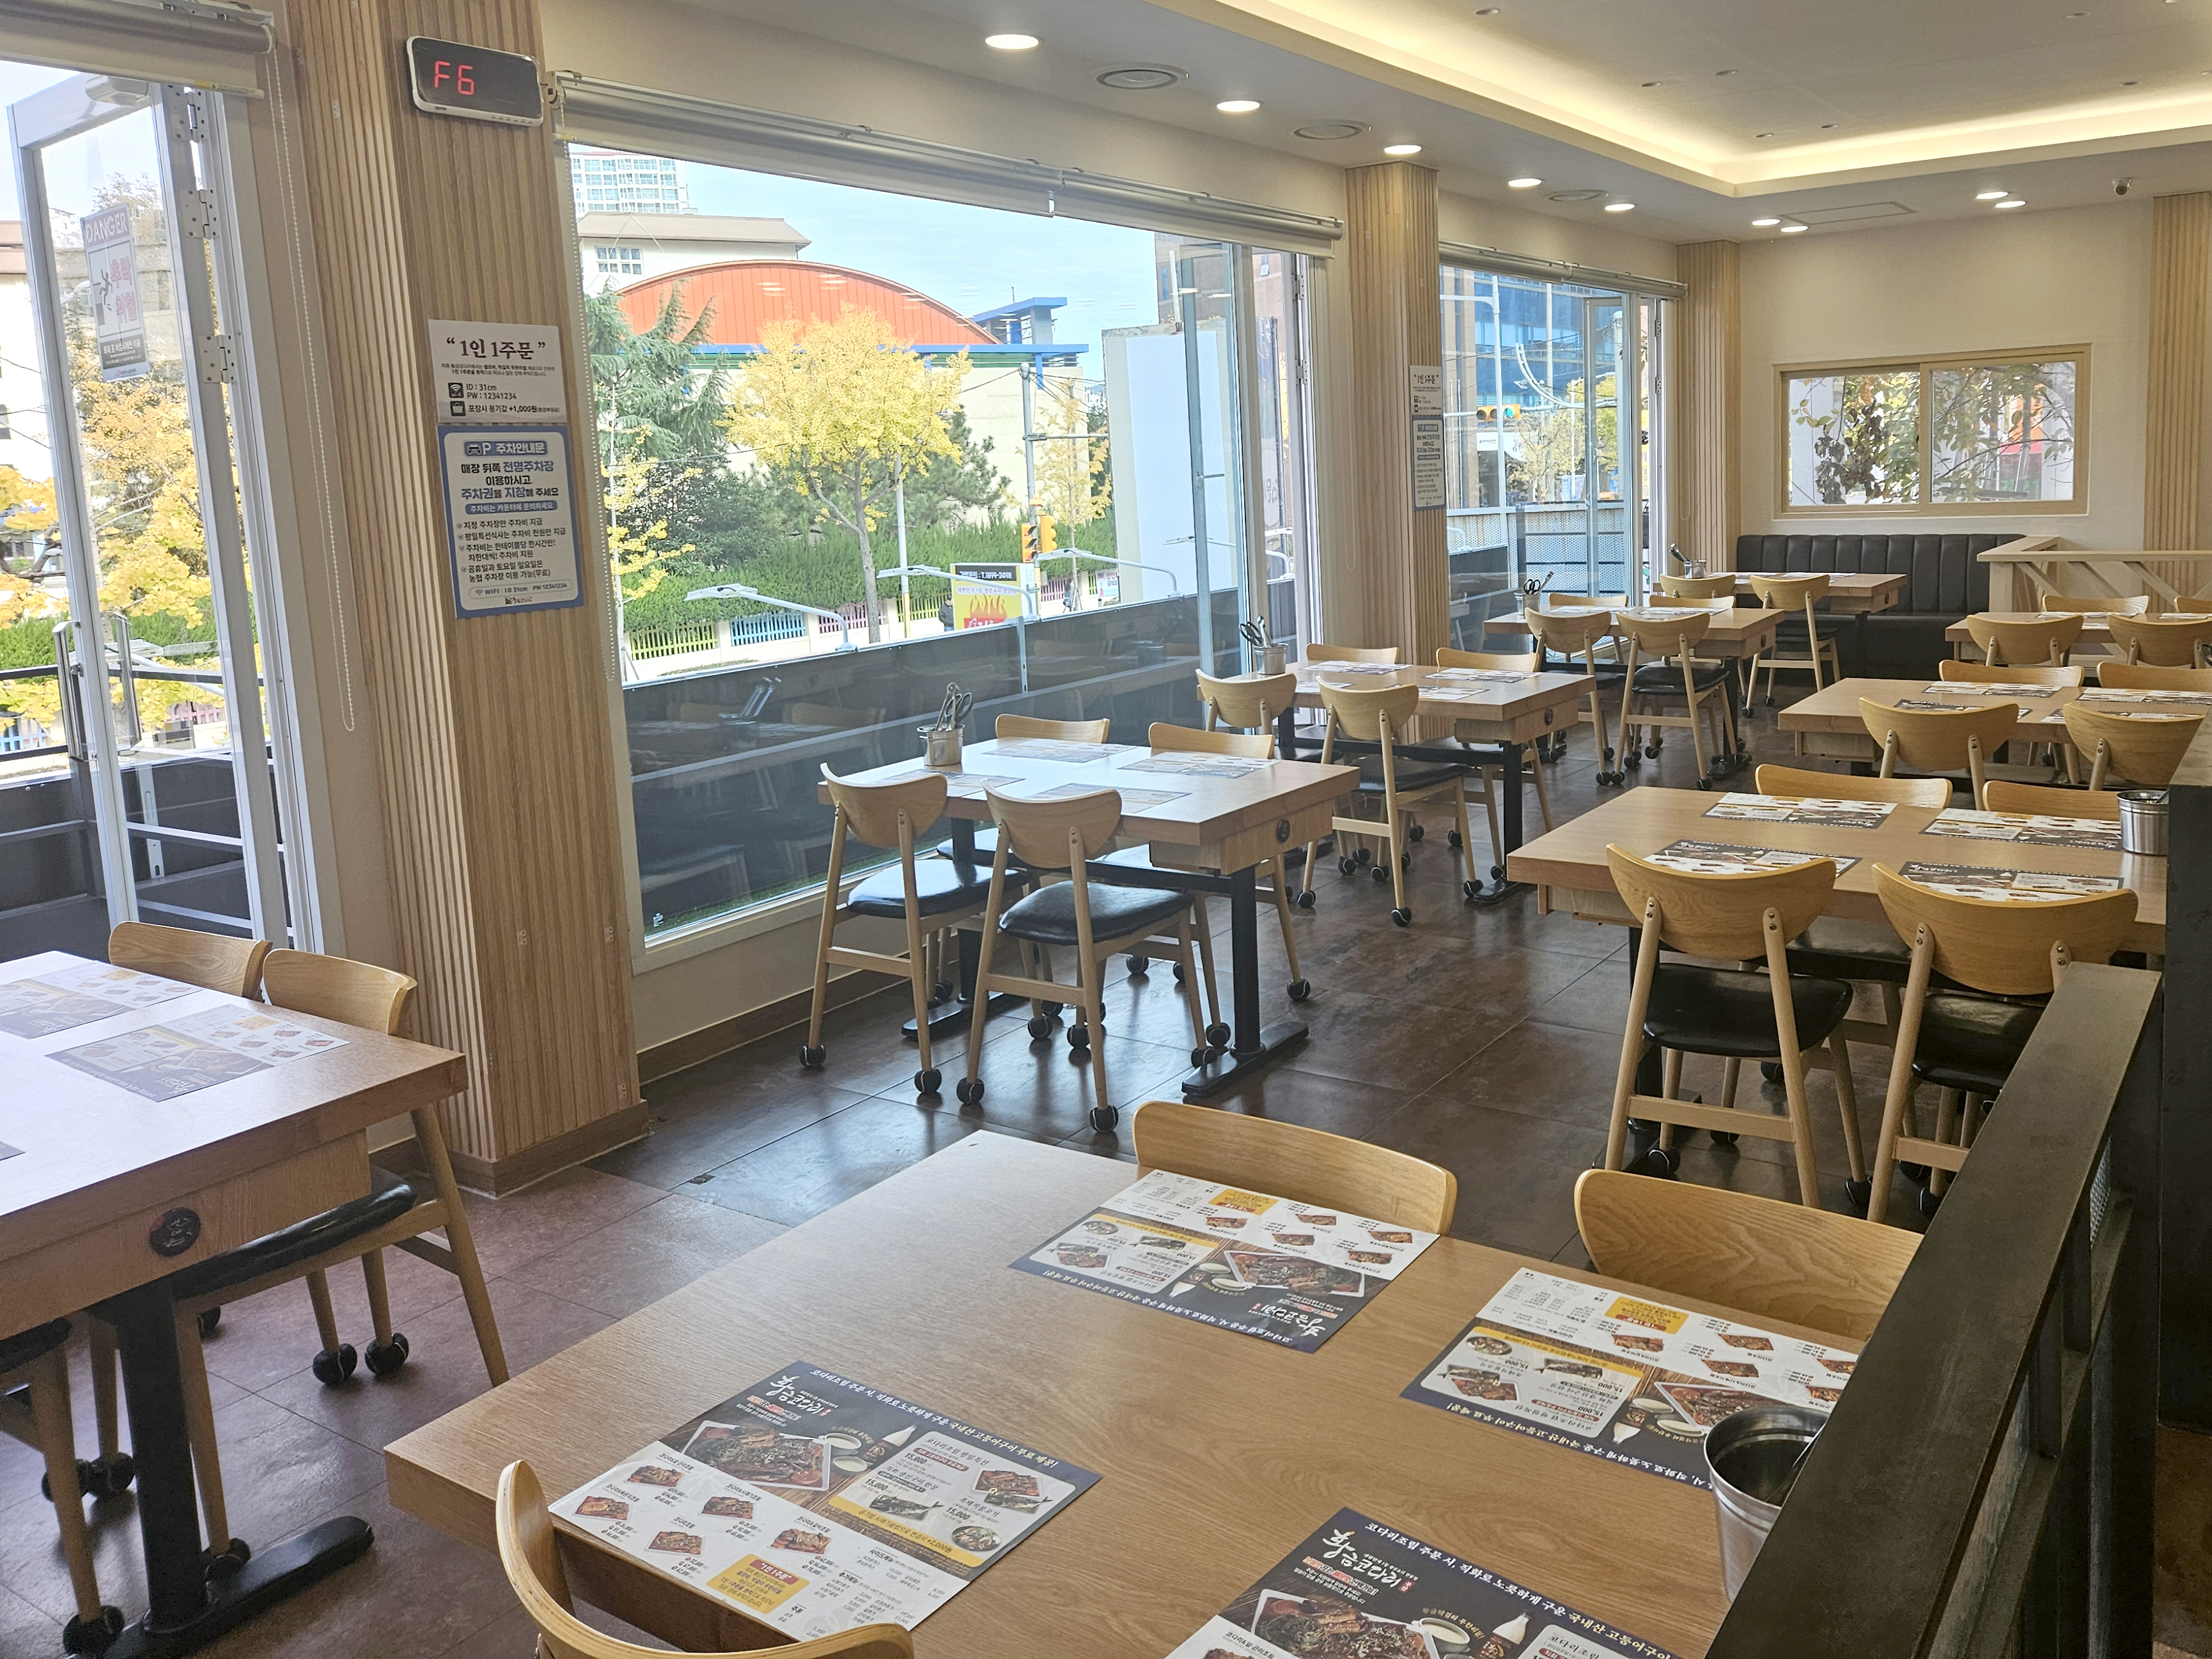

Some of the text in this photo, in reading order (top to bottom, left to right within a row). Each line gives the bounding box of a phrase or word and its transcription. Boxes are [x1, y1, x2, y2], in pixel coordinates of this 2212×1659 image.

[433, 60, 474, 95] F6
[85, 212, 129, 244] DANGER
[110, 256, 132, 289] 추락
[115, 290, 137, 323] 위험
[468, 405, 487, 413] 포장시
[489, 405, 508, 413] 용기값
[482, 442, 545, 455] P 주차안내문
[461, 463, 480, 474] 매장
[482, 463, 501, 473] 뒤쪽
[461, 487, 559, 500] 주차권을 지참해 주세요
[470, 502, 554, 513] 주차비는 카운터에 문의하세요
[463, 517, 543, 529] 지정 주차장만 주차비 지급
[532, 528, 552, 537] 천원만
[466, 543, 493, 552] 주차비는
[495, 541, 527, 551] 한테이블당
[499, 551, 518, 559] 주차비
[520, 550, 533, 558] 지원
[468, 560, 543, 573] 공휴일과 토요일 일요일은
[469, 574, 483, 583] 농협
[484, 573, 504, 582] 주차장
[506, 572, 519, 580] 이용
[769, 1375, 824, 1416] 황금코다리
[811, 1370, 850, 1386] 코다리조림
[848, 1383, 866, 1392] 주문
[876, 1394, 900, 1406] 직화로
[898, 1403, 933, 1419] 노릇하게
[932, 1415, 949, 1425] 구운
[950, 1422, 976, 1435] 국내산
[973, 1433, 1018, 1451] 고등어구이
[1017, 1449, 1035, 1459] 무료
[1035, 1456, 1059, 1467] 제공!
[905, 1453, 927, 1464] 15,000
[866, 1479, 888, 1490] 15,000
[946, 1507, 970, 1520] 15,000
[928, 1539, 953, 1553] +2,000원
[1323, 1529, 1403, 1587] 황금코다리
[1366, 1523, 1419, 1549] 코다리조림
[1420, 1546, 1442, 1560] 주문
[1443, 1557, 1456, 1568] 시,
[1460, 1564, 1492, 1582] 직화로
[1493, 1580, 1541, 1605] 노릇하게
[1543, 1601, 1566, 1616] 구운
[1569, 1613, 1605, 1633] 국내산
